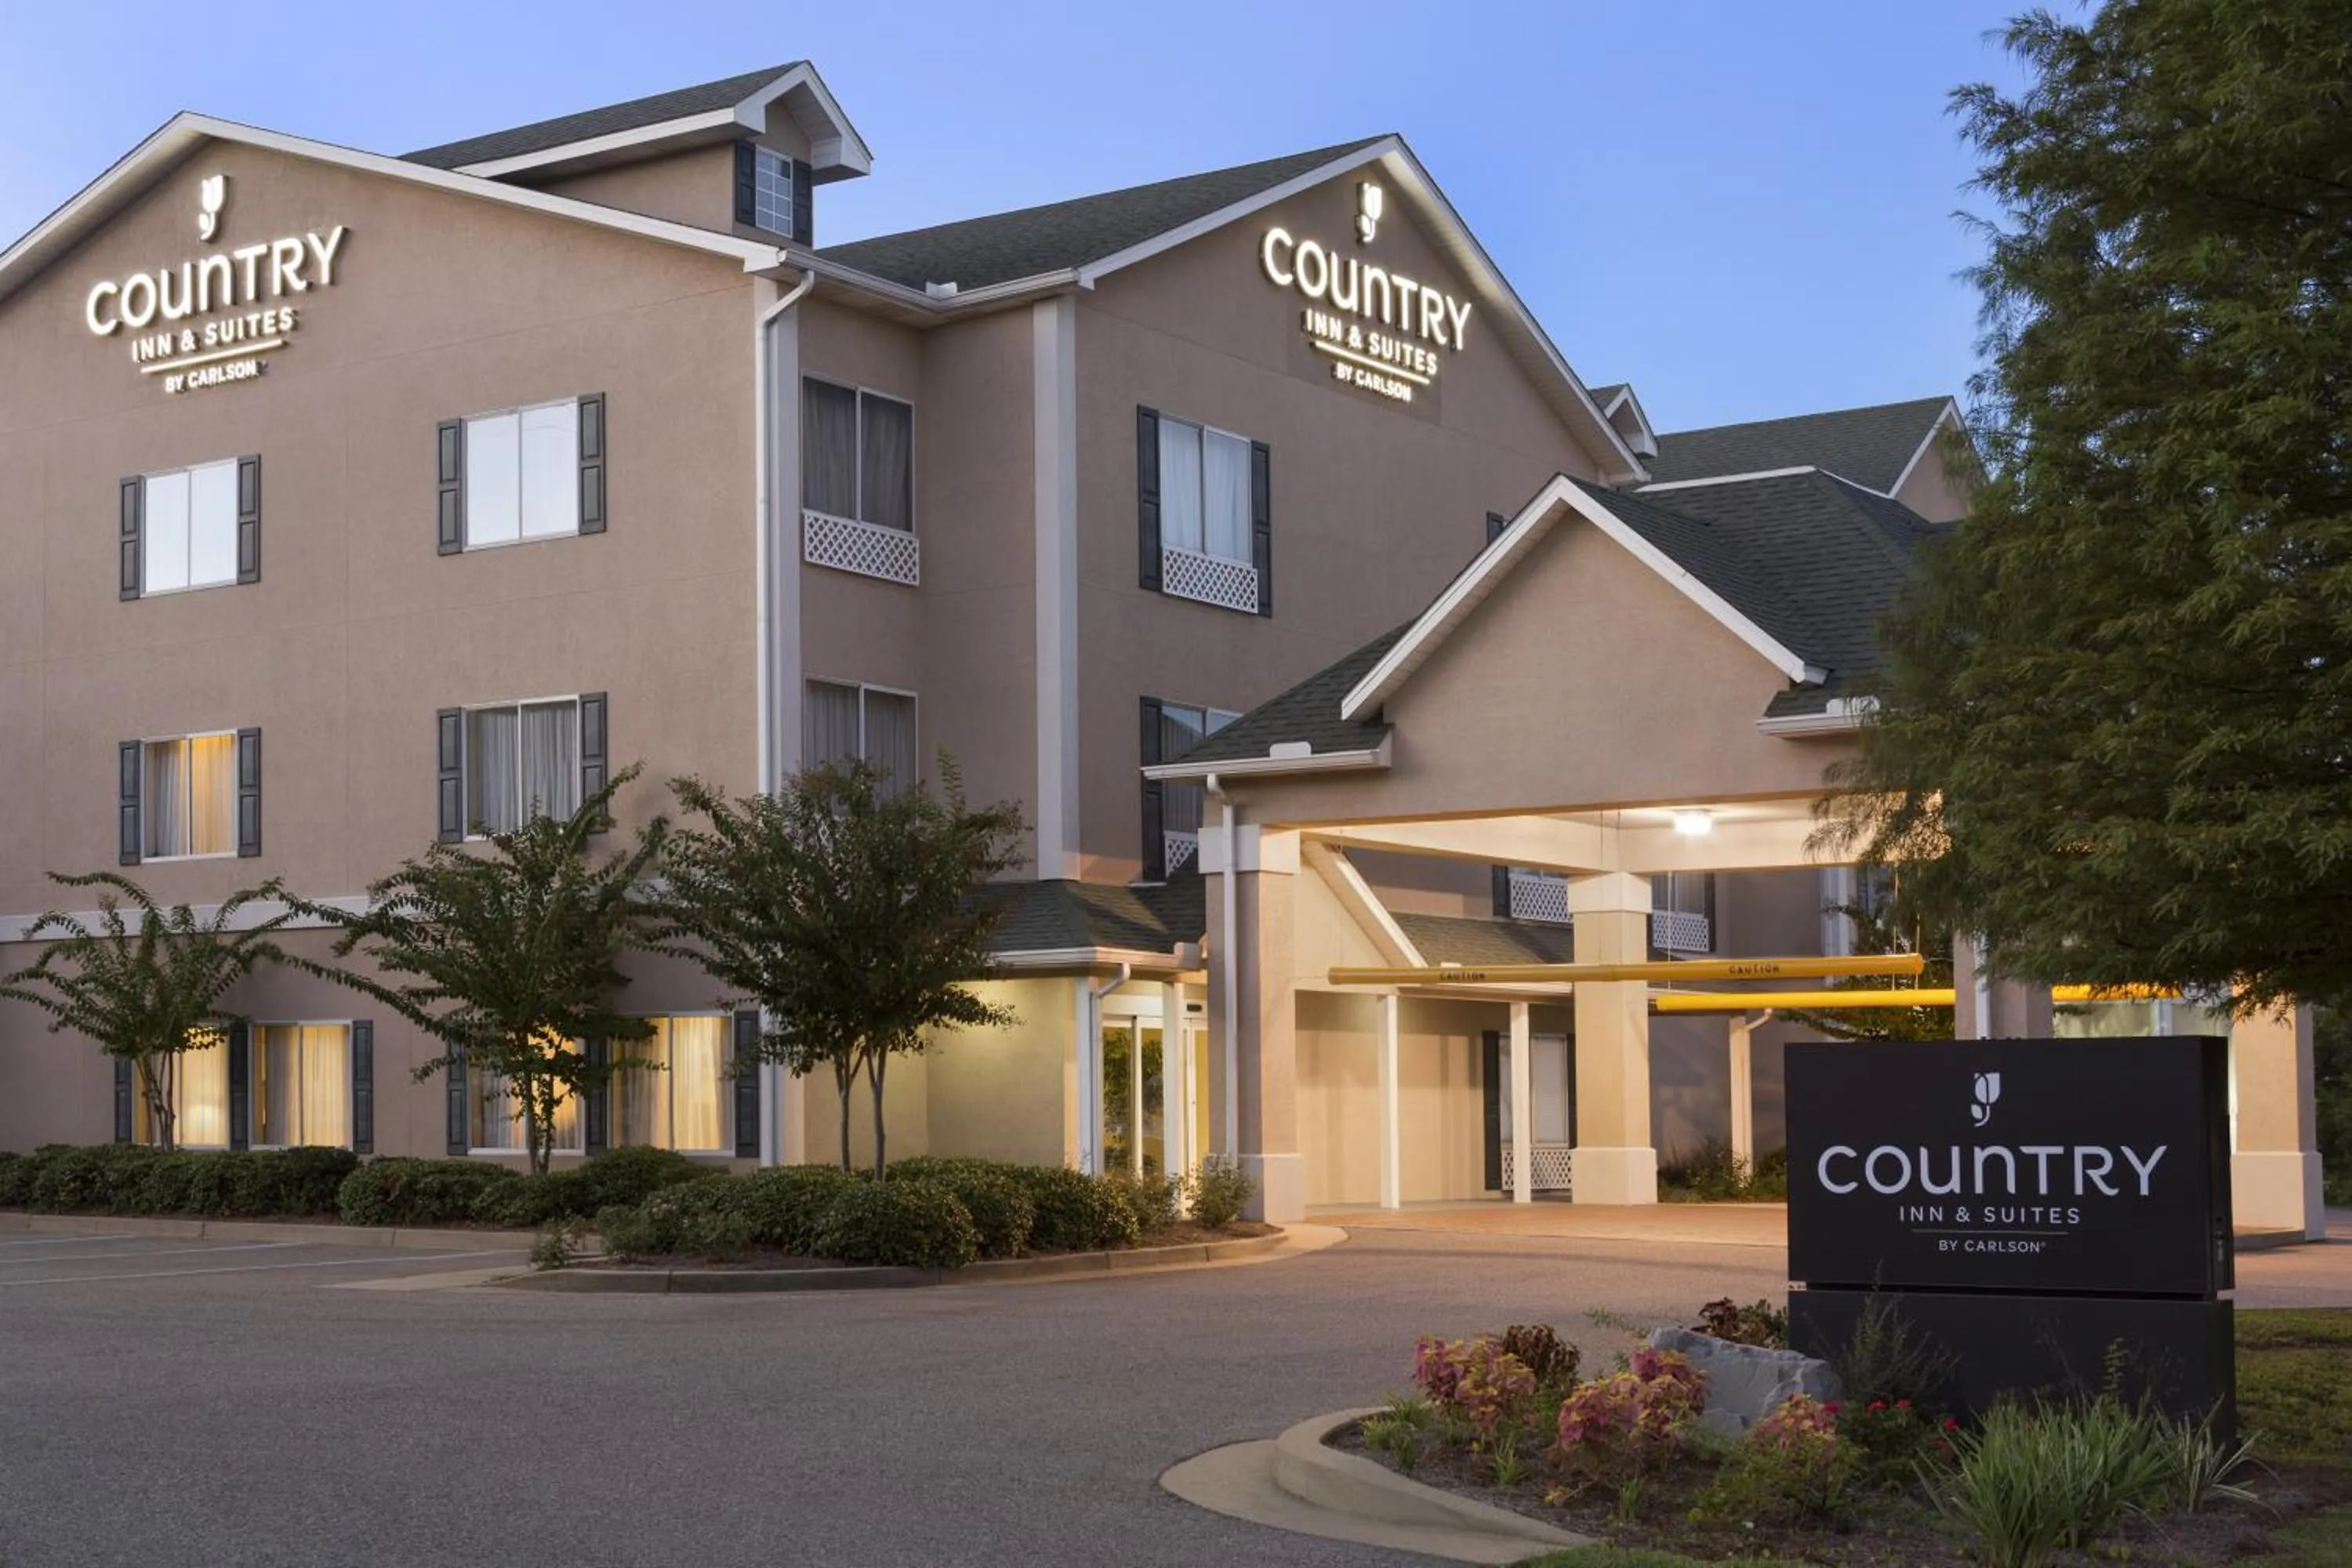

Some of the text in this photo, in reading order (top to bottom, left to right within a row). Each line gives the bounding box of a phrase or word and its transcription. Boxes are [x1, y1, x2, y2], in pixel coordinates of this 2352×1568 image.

[131, 306, 294, 363] INN & SUITES
[1306, 308, 1438, 376] INN & SUITES
[164, 359, 257, 394] BY CARLSON
[1336, 361, 1413, 402] BY CARLSON
[1899, 1206, 2081, 1225] INN & SUITES
[1938, 1240, 1958, 1252] BY
